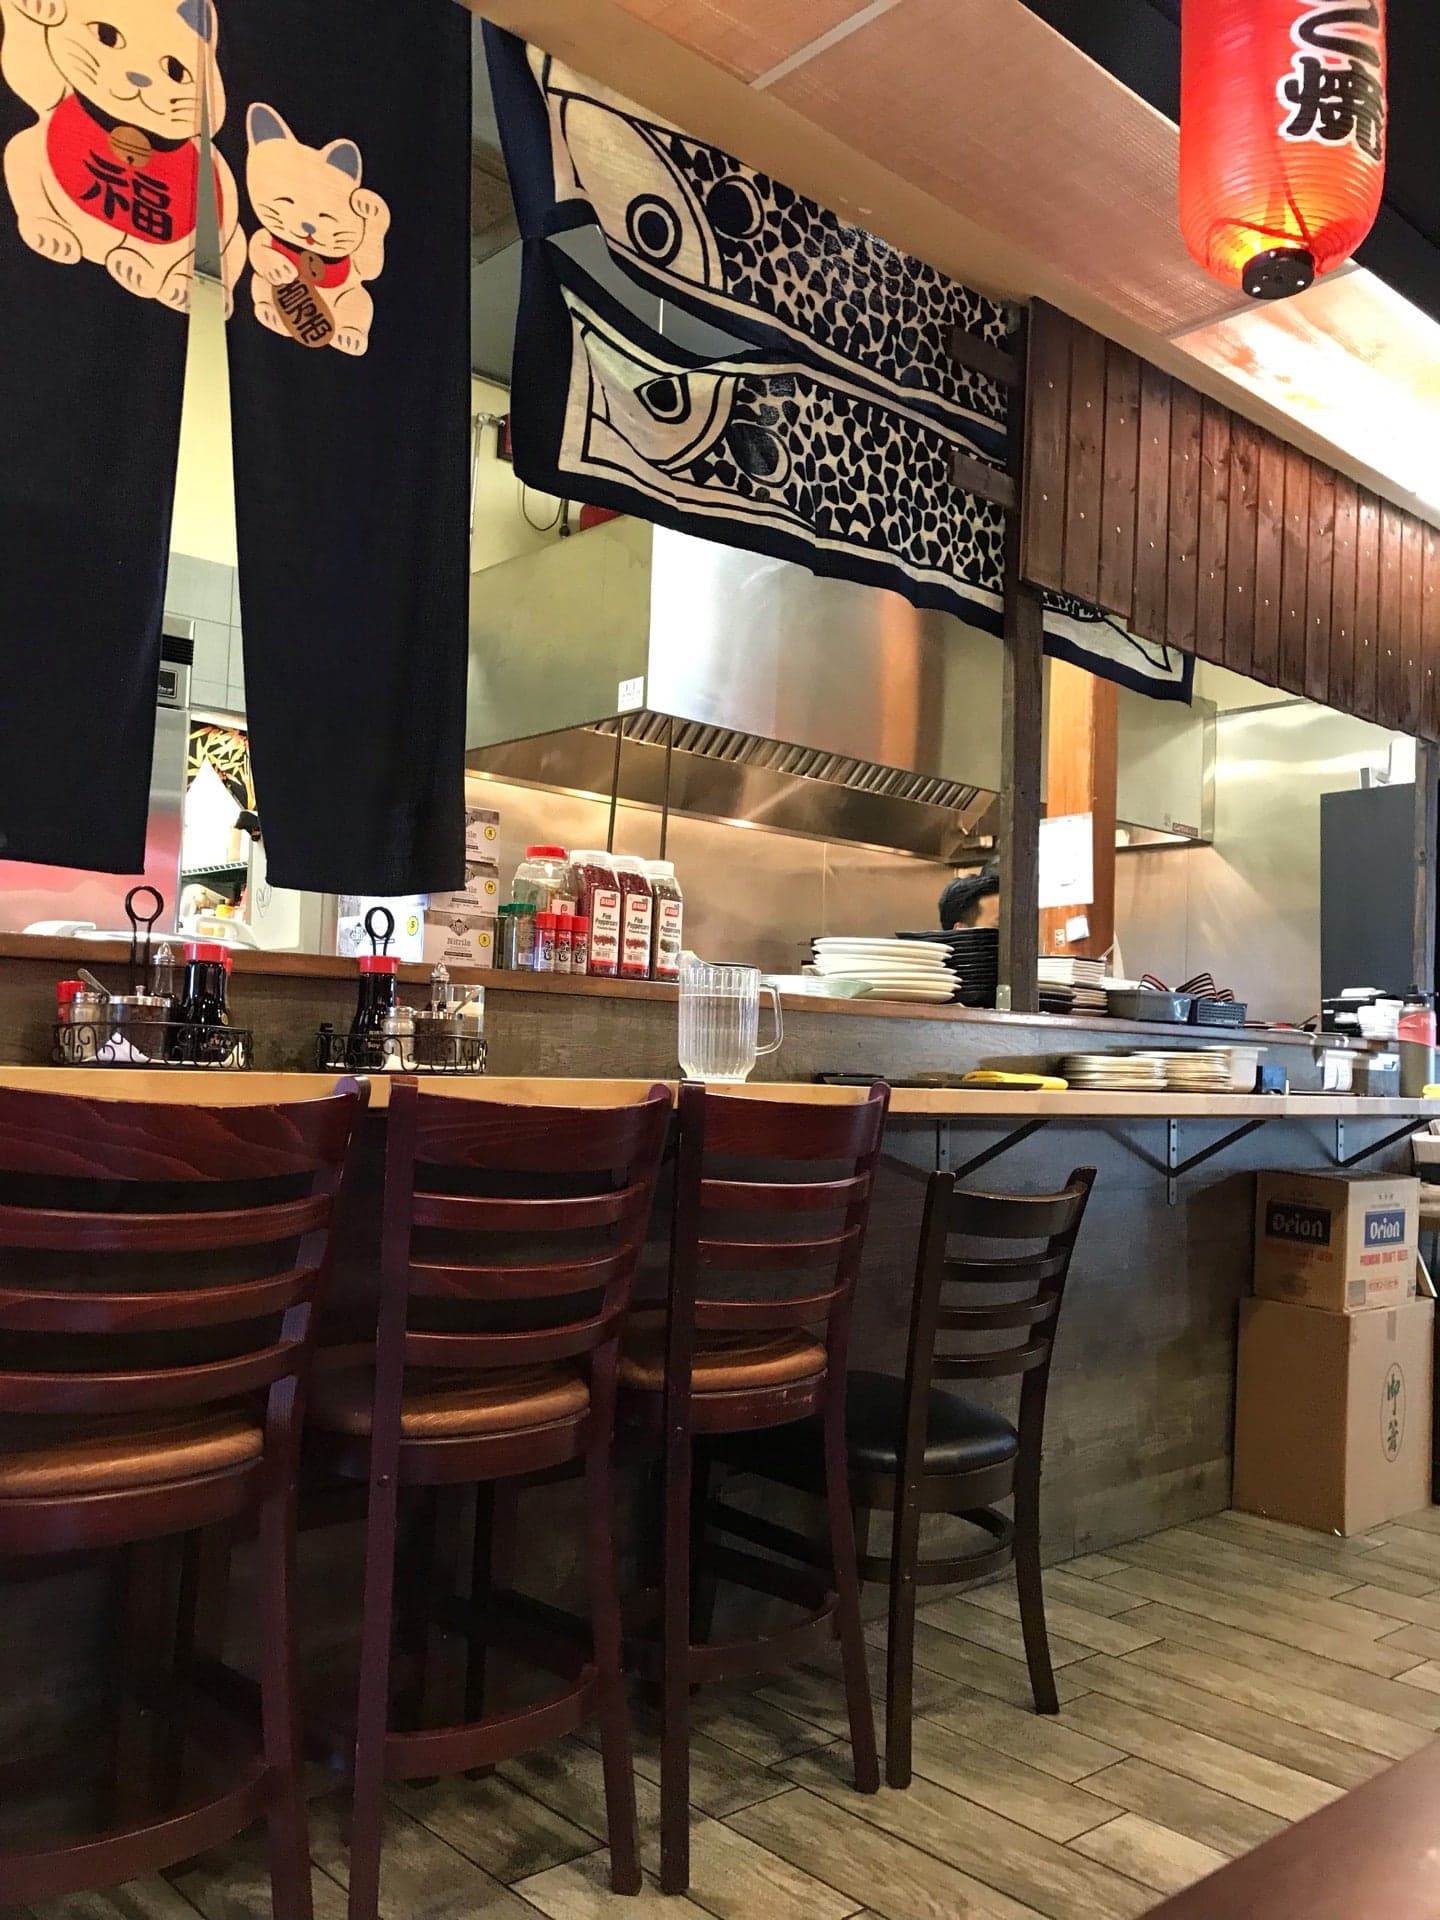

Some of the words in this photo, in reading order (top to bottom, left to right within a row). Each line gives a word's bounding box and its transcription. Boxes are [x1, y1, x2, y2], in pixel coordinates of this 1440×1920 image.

[80, 149, 173, 241] 福
[1272, 1213, 1324, 1239] Orion
[1370, 1217, 1400, 1240] Orion
